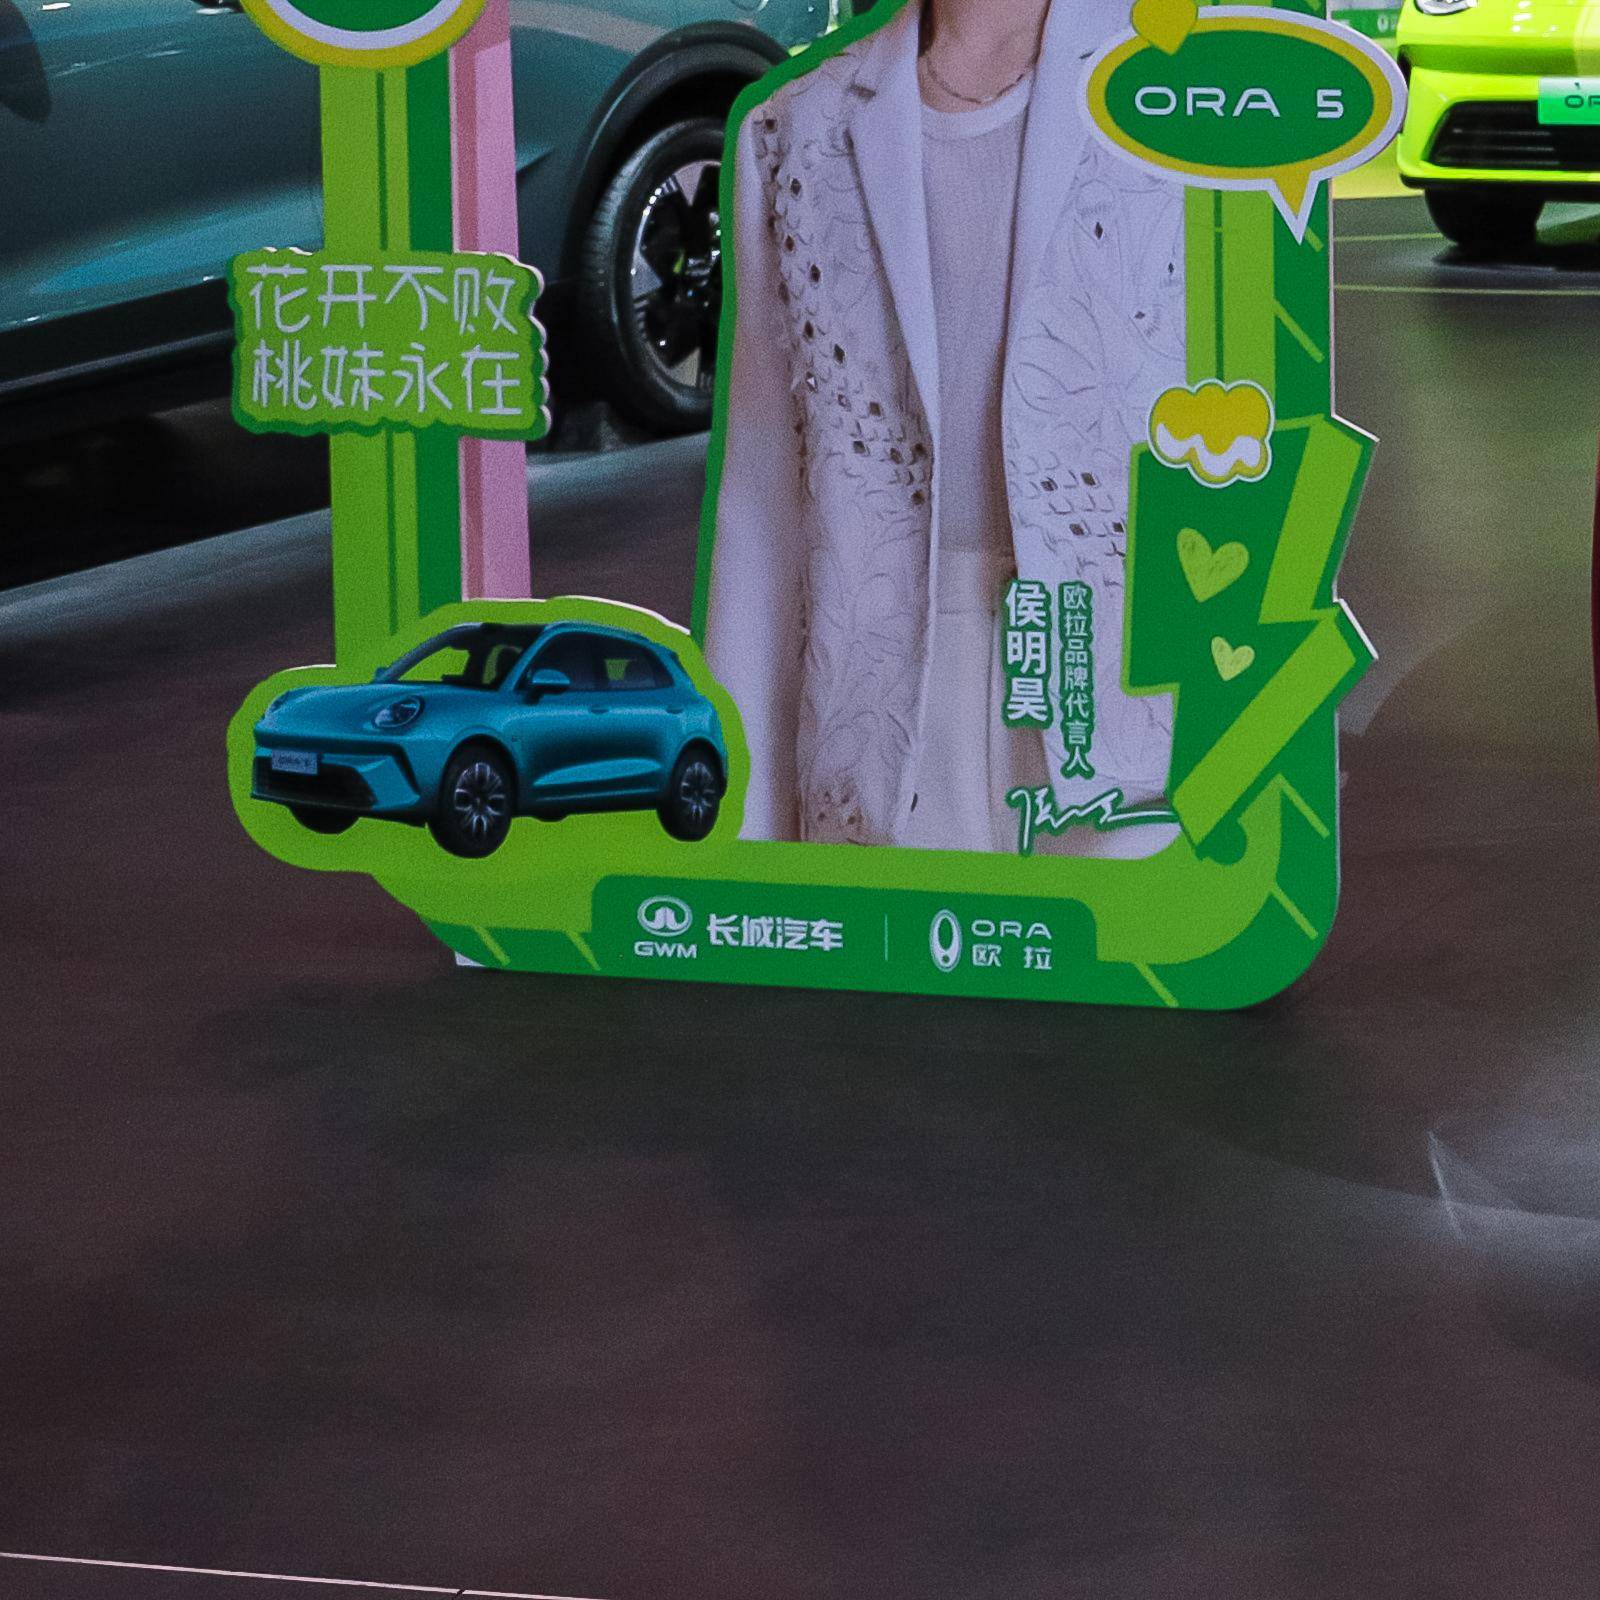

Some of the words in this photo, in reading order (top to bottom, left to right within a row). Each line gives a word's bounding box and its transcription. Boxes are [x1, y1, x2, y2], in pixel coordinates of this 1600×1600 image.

[1134, 85, 1281, 117] ORA
[1316, 89, 1344, 119] 5
[246, 263, 519, 335] 花开不败
[252, 340, 522, 416] 桃妹永在
[1005, 581, 1049, 722] 侯明昊
[1062, 585, 1091, 773] 欧拉品牌代言人
[633, 940, 697, 959] GWM
[706, 913, 844, 952] 长城汽车
[970, 919, 1053, 940] ORA
